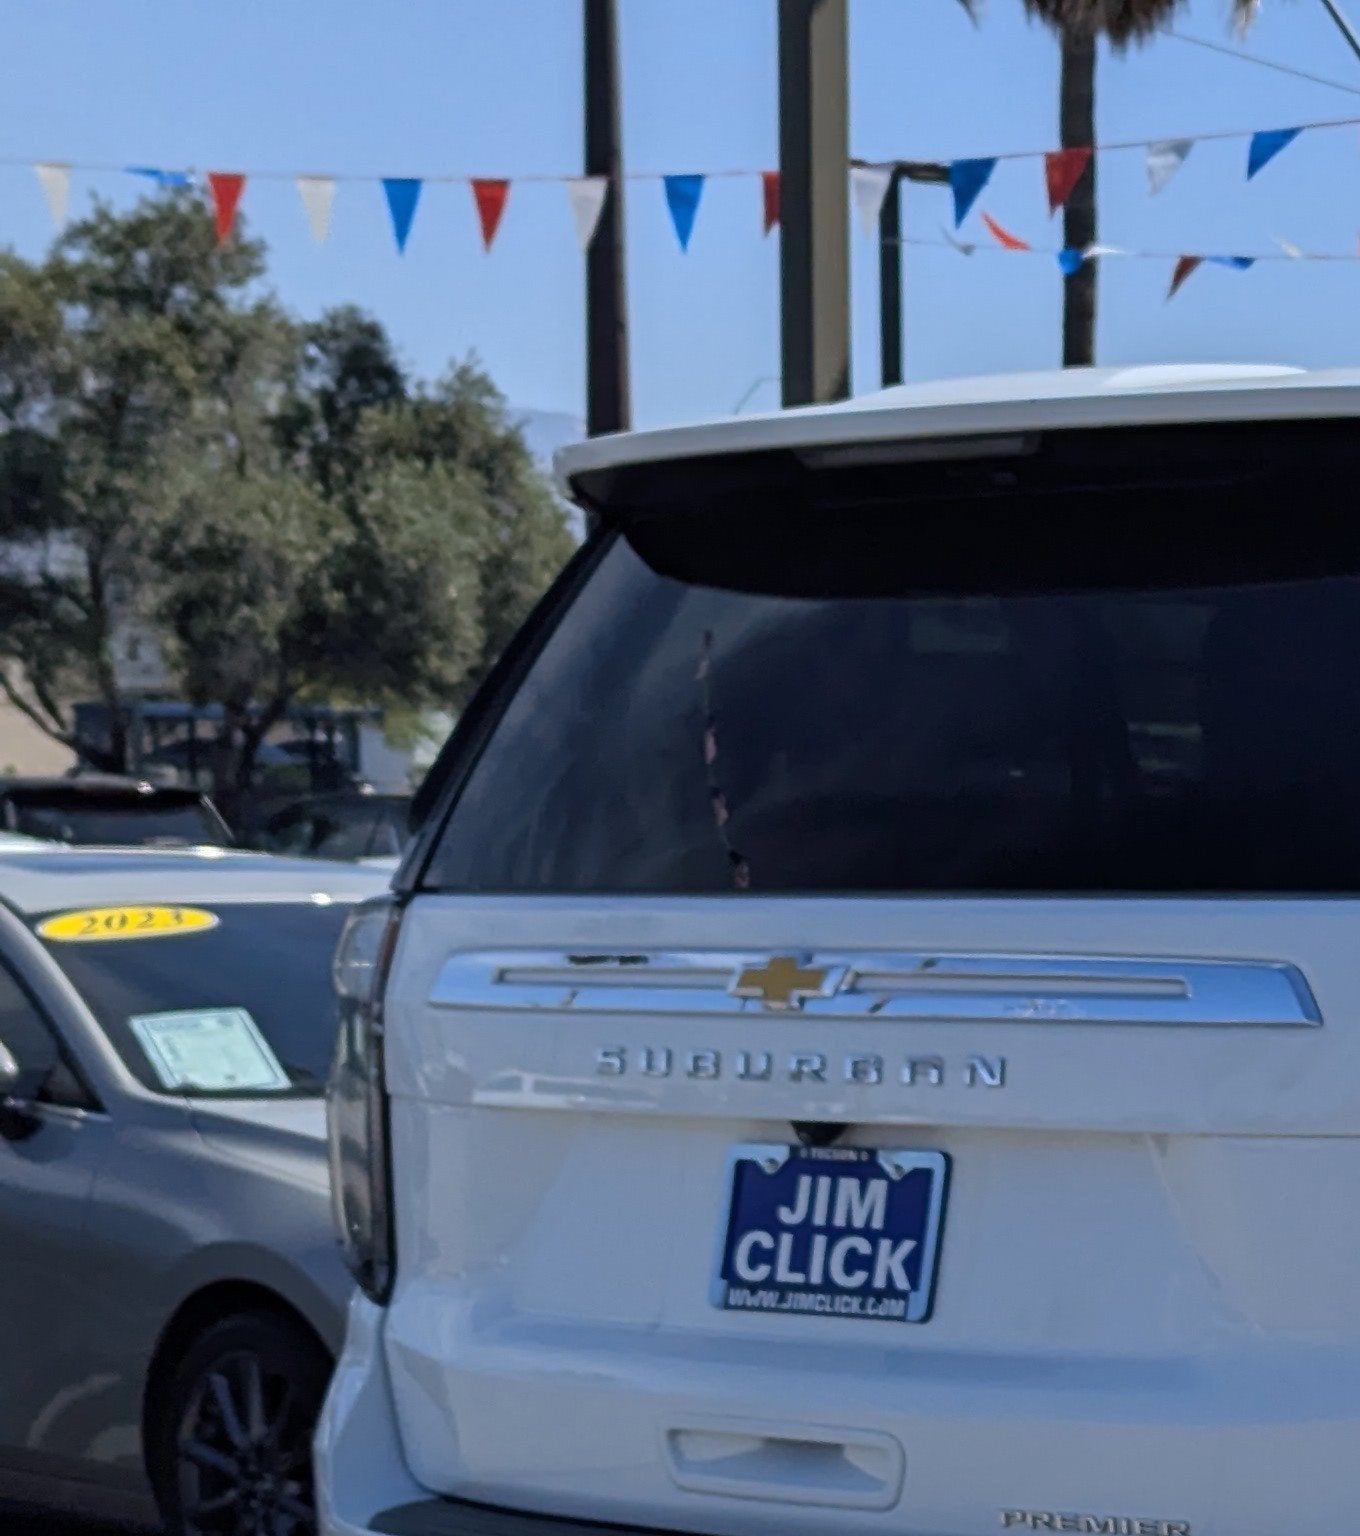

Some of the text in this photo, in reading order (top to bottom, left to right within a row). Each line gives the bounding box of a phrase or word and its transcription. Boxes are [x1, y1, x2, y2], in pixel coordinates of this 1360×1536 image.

[79, 907, 184, 935] 2023
[597, 1045, 1008, 1088] SUBURBAN
[776, 1173, 889, 1231] JIM
[735, 1230, 918, 1291] CLICK
